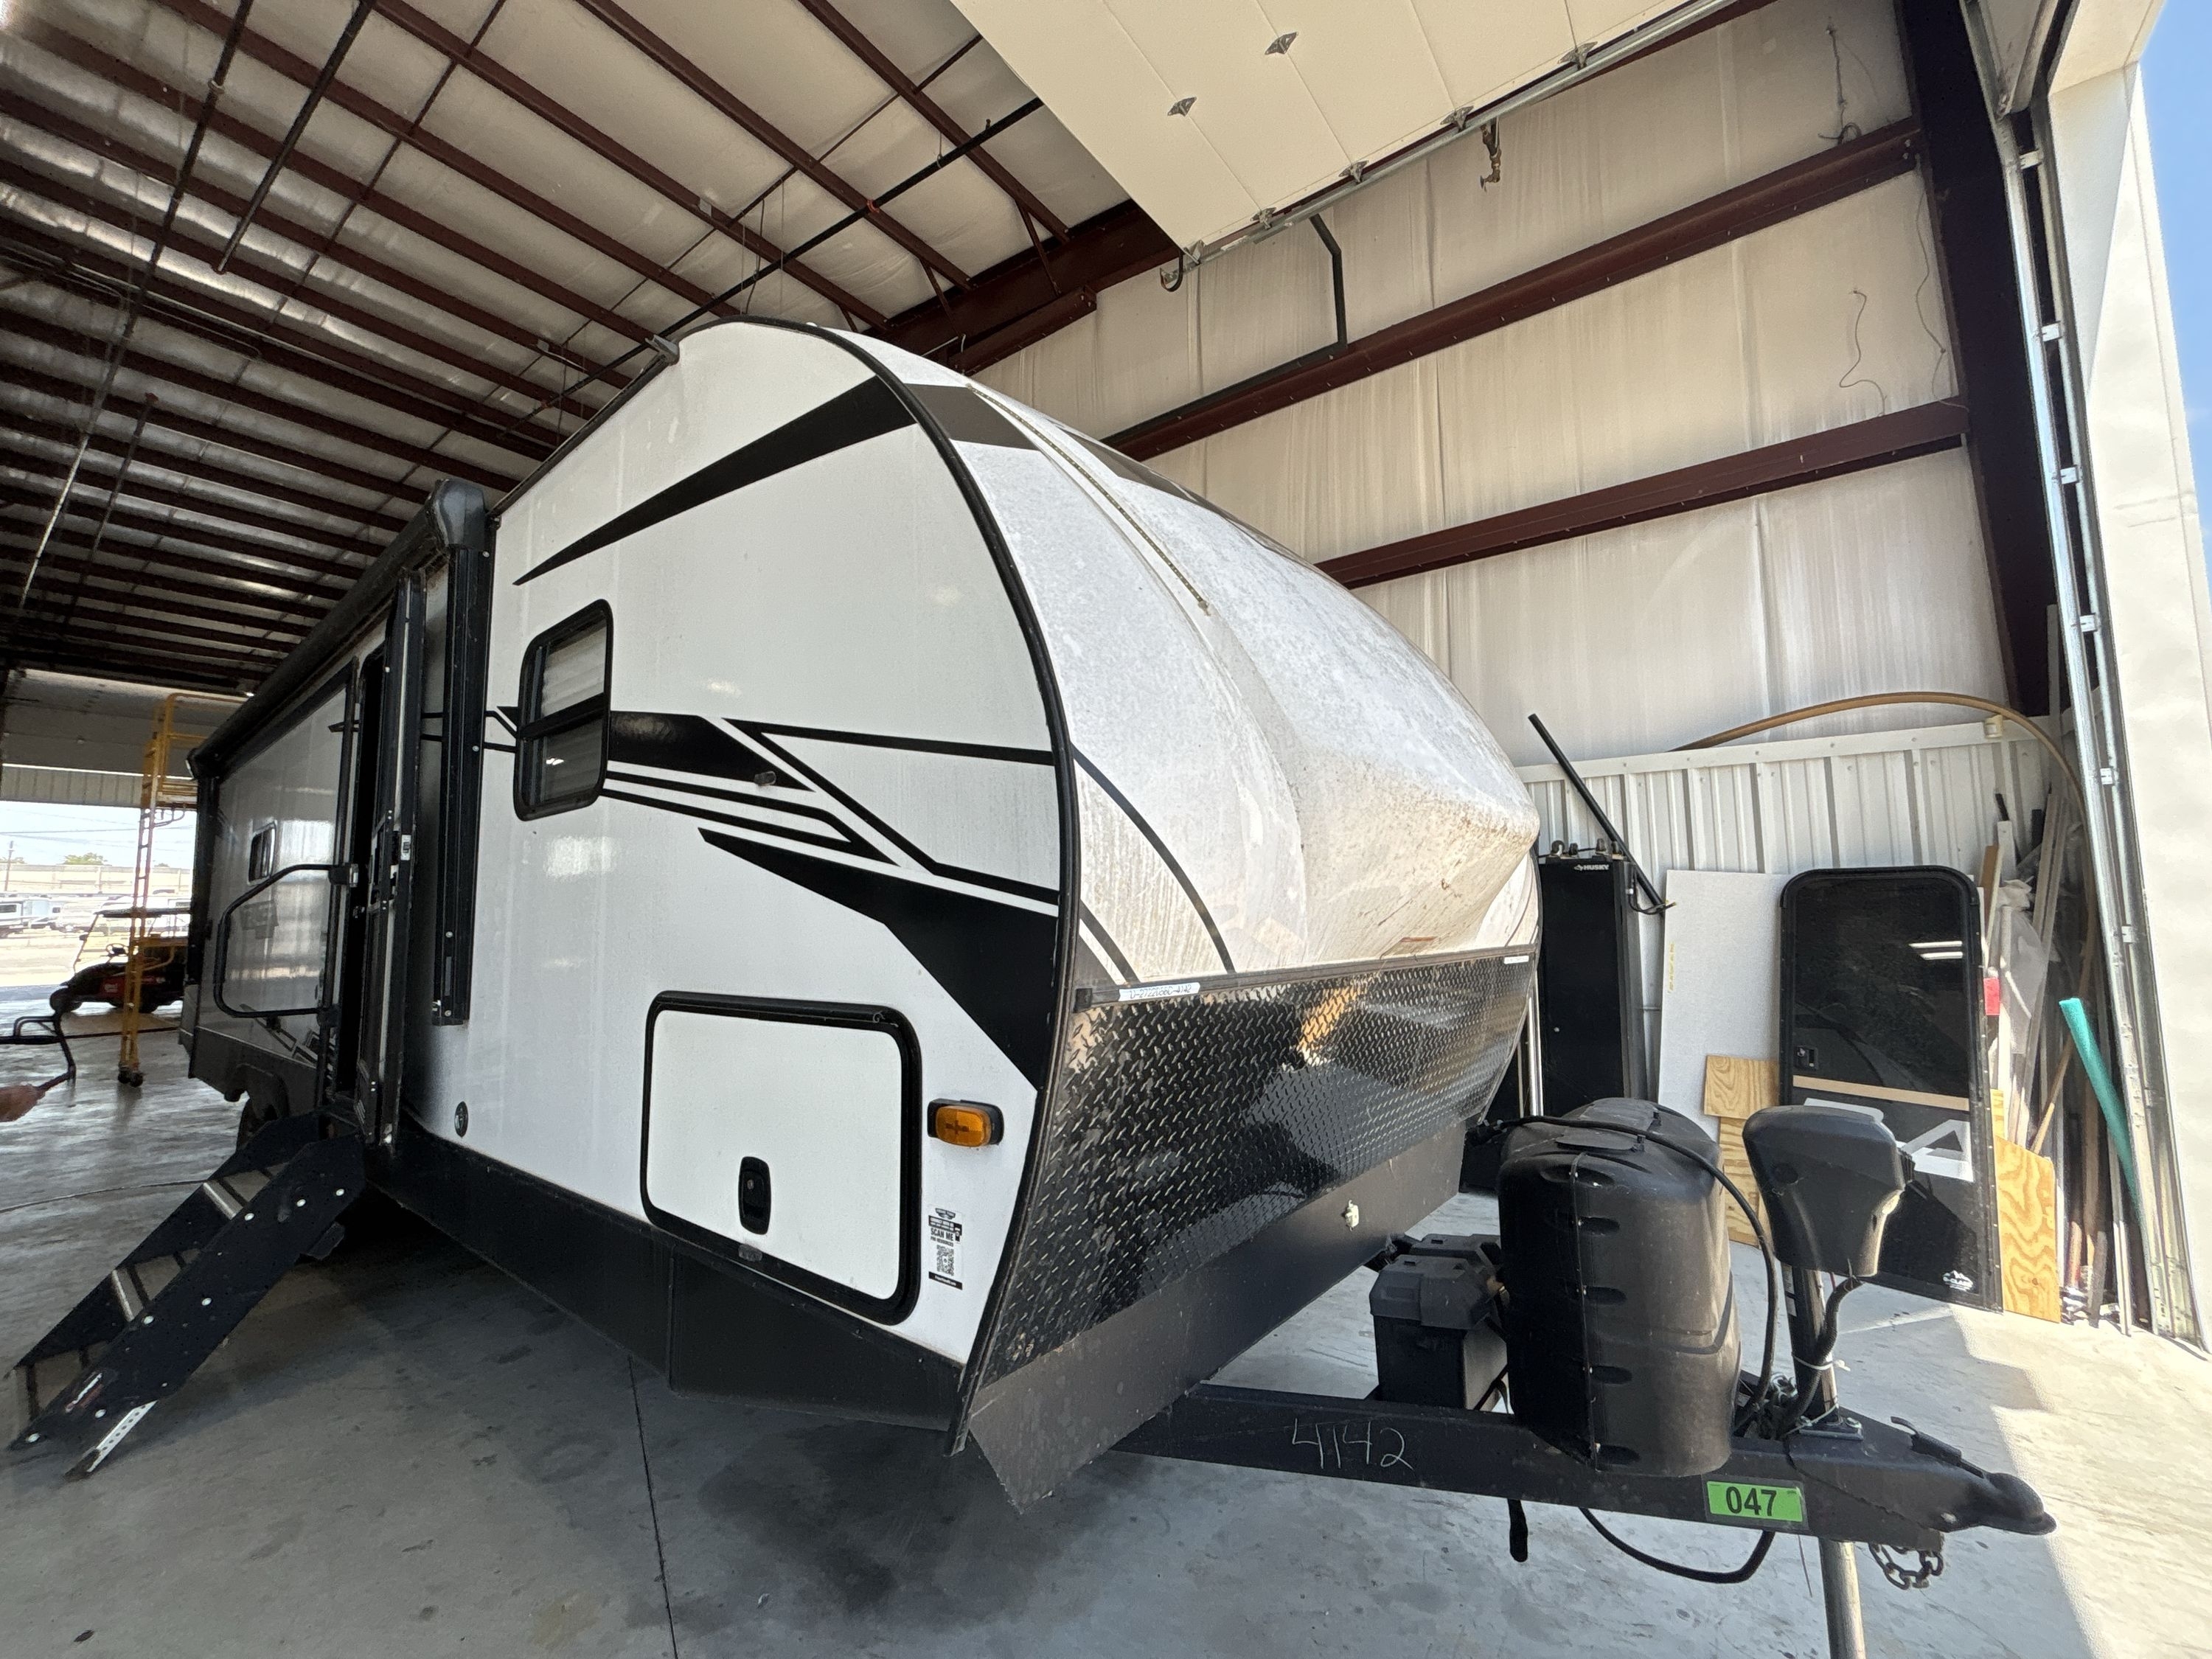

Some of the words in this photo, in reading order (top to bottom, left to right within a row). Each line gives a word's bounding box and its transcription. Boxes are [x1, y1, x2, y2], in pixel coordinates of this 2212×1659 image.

[931, 1227, 945, 1239] SCAN
[945, 1231, 954, 1241] ME
[1292, 1417, 1415, 1471] 4142
[1725, 1486, 1777, 1517] 047
